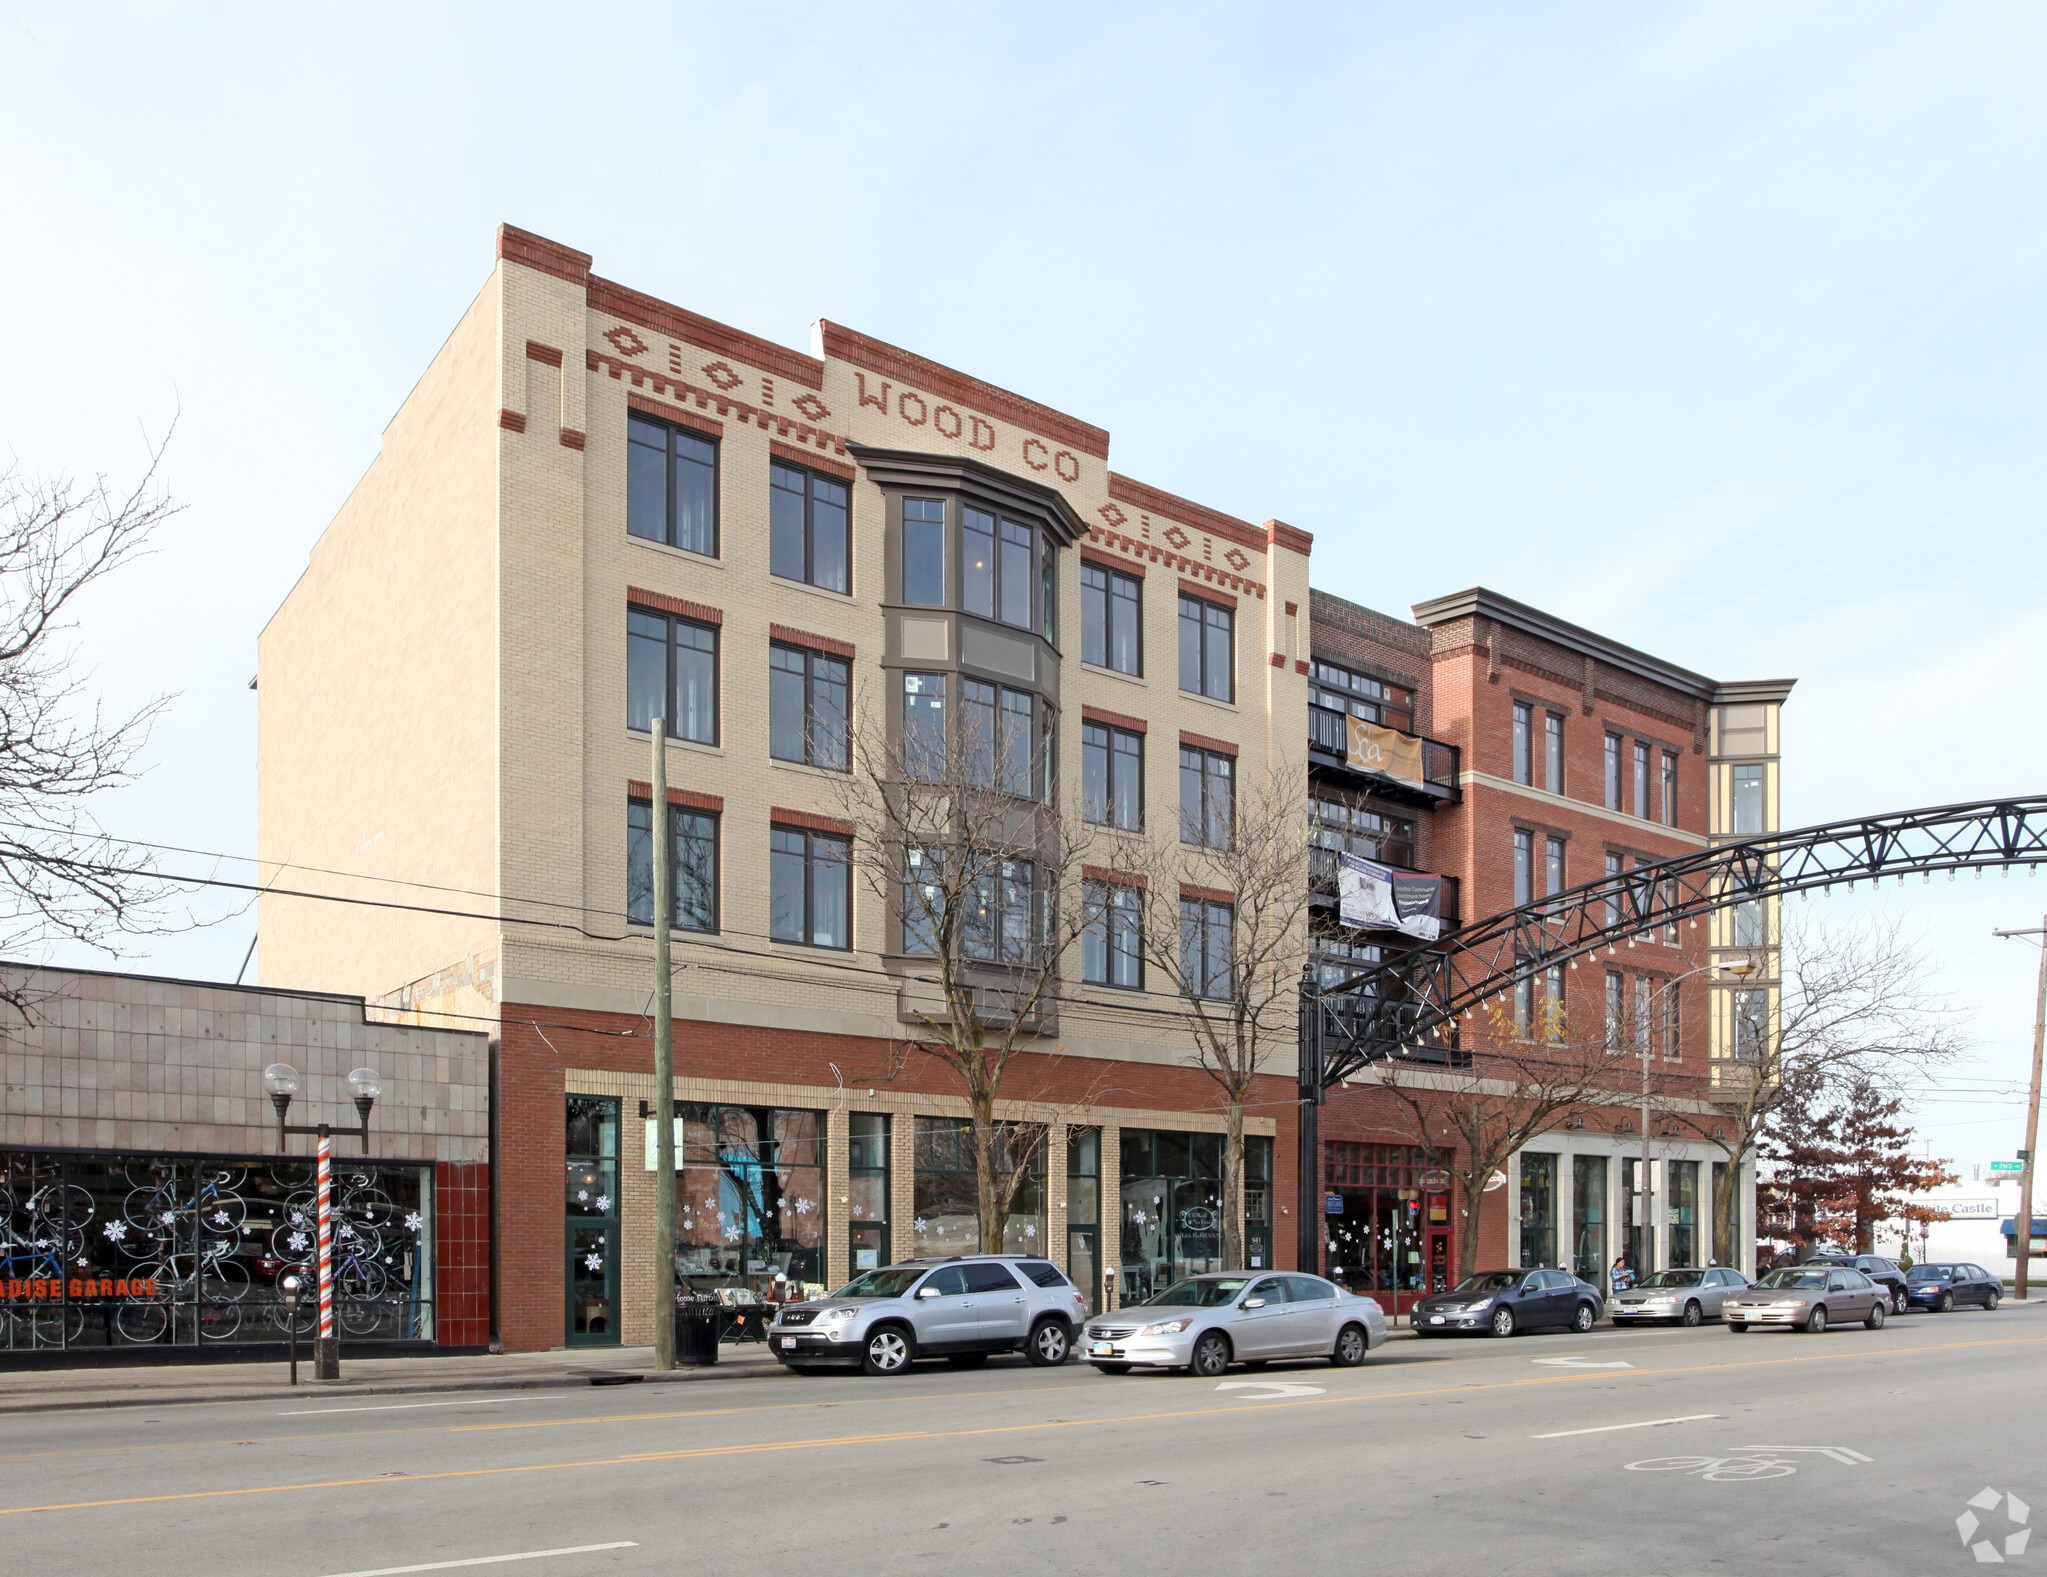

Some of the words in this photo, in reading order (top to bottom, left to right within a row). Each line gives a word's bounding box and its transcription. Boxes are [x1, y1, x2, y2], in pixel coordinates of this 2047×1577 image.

[854, 371, 995, 452] WOOD
[1022, 438, 1080, 483] CO
[1952, 1203, 1993, 1214] Castle
[1251, 1236, 1261, 1244] 941
[69, 1278, 158, 1298] GARAGE
